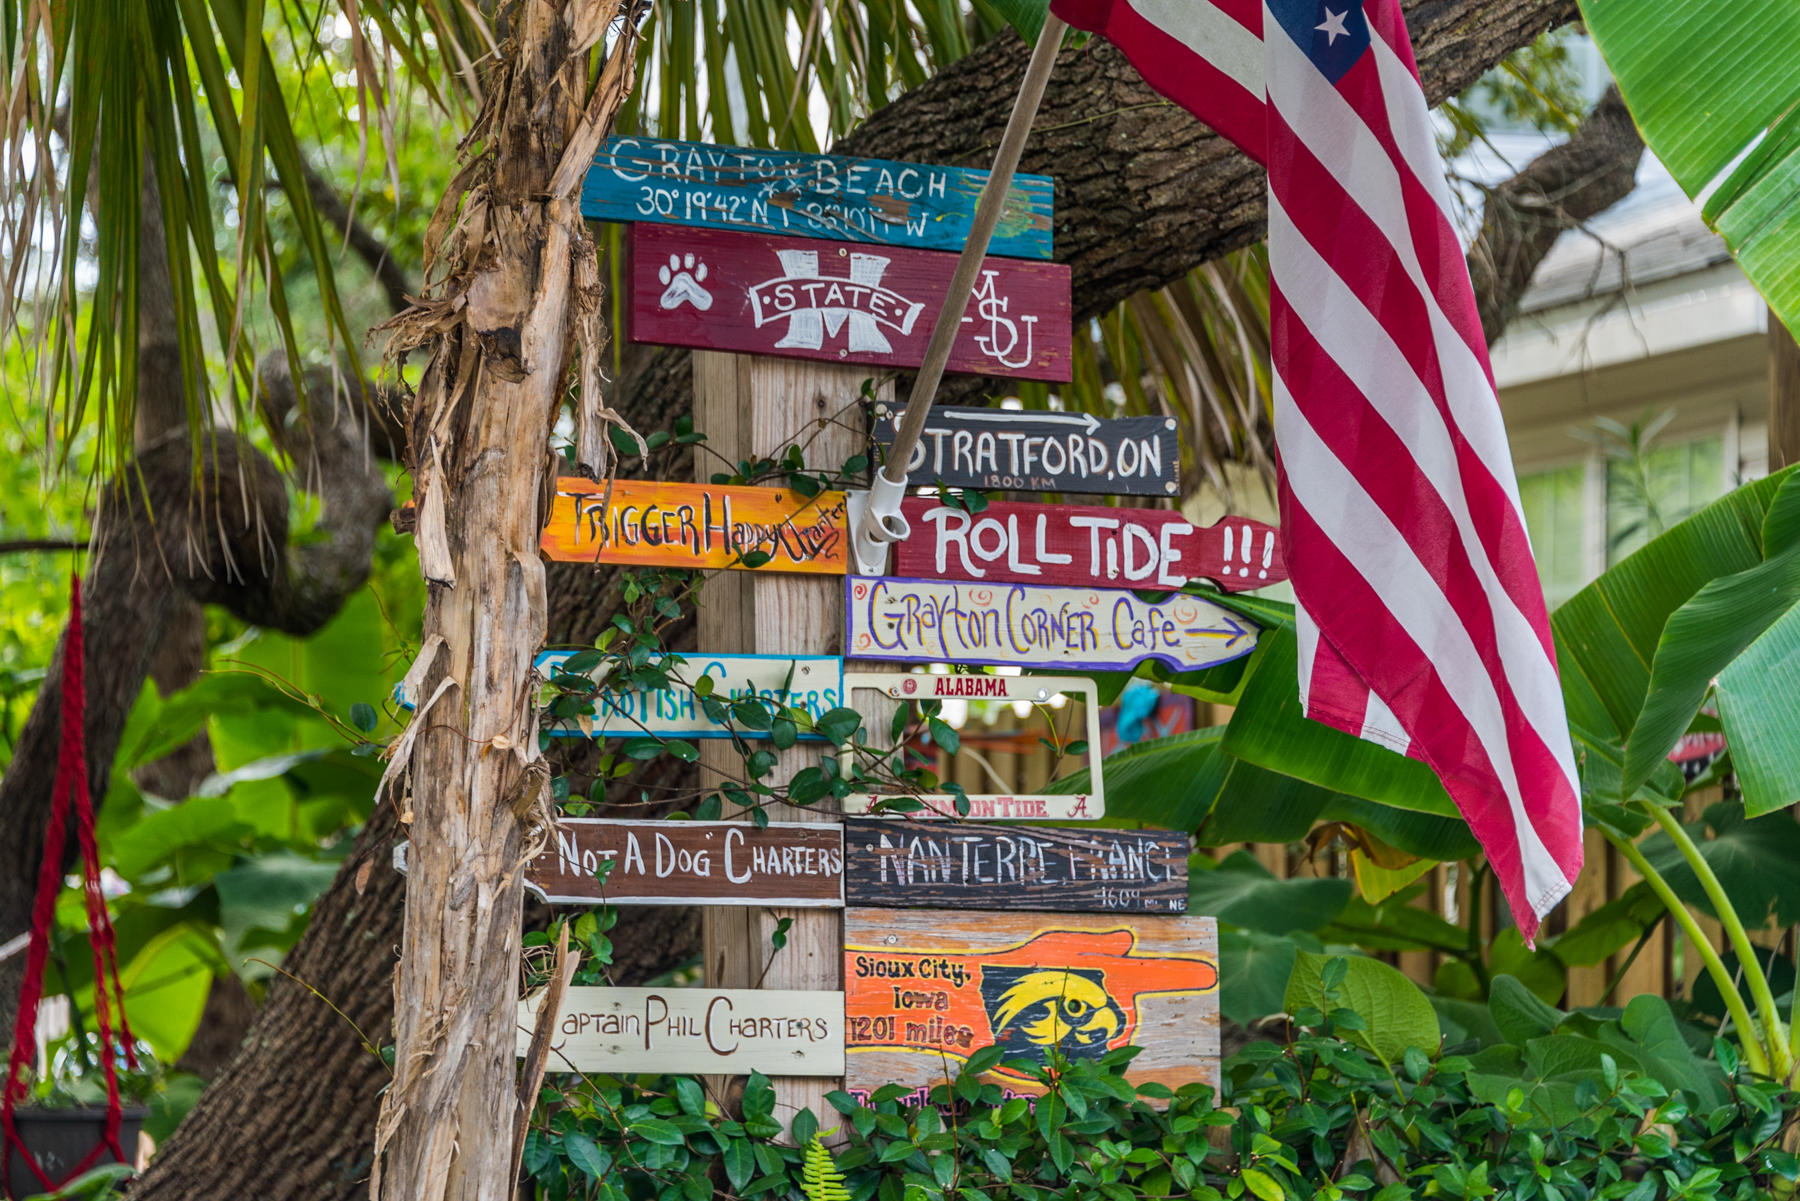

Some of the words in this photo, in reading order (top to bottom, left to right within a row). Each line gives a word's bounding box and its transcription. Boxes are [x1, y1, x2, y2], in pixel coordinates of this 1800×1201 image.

[610, 139, 801, 184] GRAYTON
[814, 159, 947, 199] BEACH
[774, 282, 896, 317] STATE
[984, 475, 1025, 489] 1800
[1030, 476, 1057, 490] KM
[557, 491, 701, 556] TRIGGER
[922, 506, 1072, 578] ROLL
[1070, 516, 1194, 587] TIDE
[1006, 583, 1098, 654] CORNER
[1112, 597, 1180, 651] Cafe
[934, 677, 1008, 697] ALABAMA
[997, 797, 1048, 818] TIDE
[559, 831, 618, 877] NOT
[624, 831, 646, 876] A
[725, 828, 843, 884] CHARTERS
[855, 956, 915, 978] Sioux
[918, 958, 971, 988] City,
[893, 986, 949, 1010] Iowa
[552, 1013, 640, 1051] aPTaIn
[645, 995, 702, 1051] PHIL
[705, 996, 830, 1056] CHaRTERS
[850, 1016, 895, 1041] 1201
[906, 1015, 974, 1048] miles
